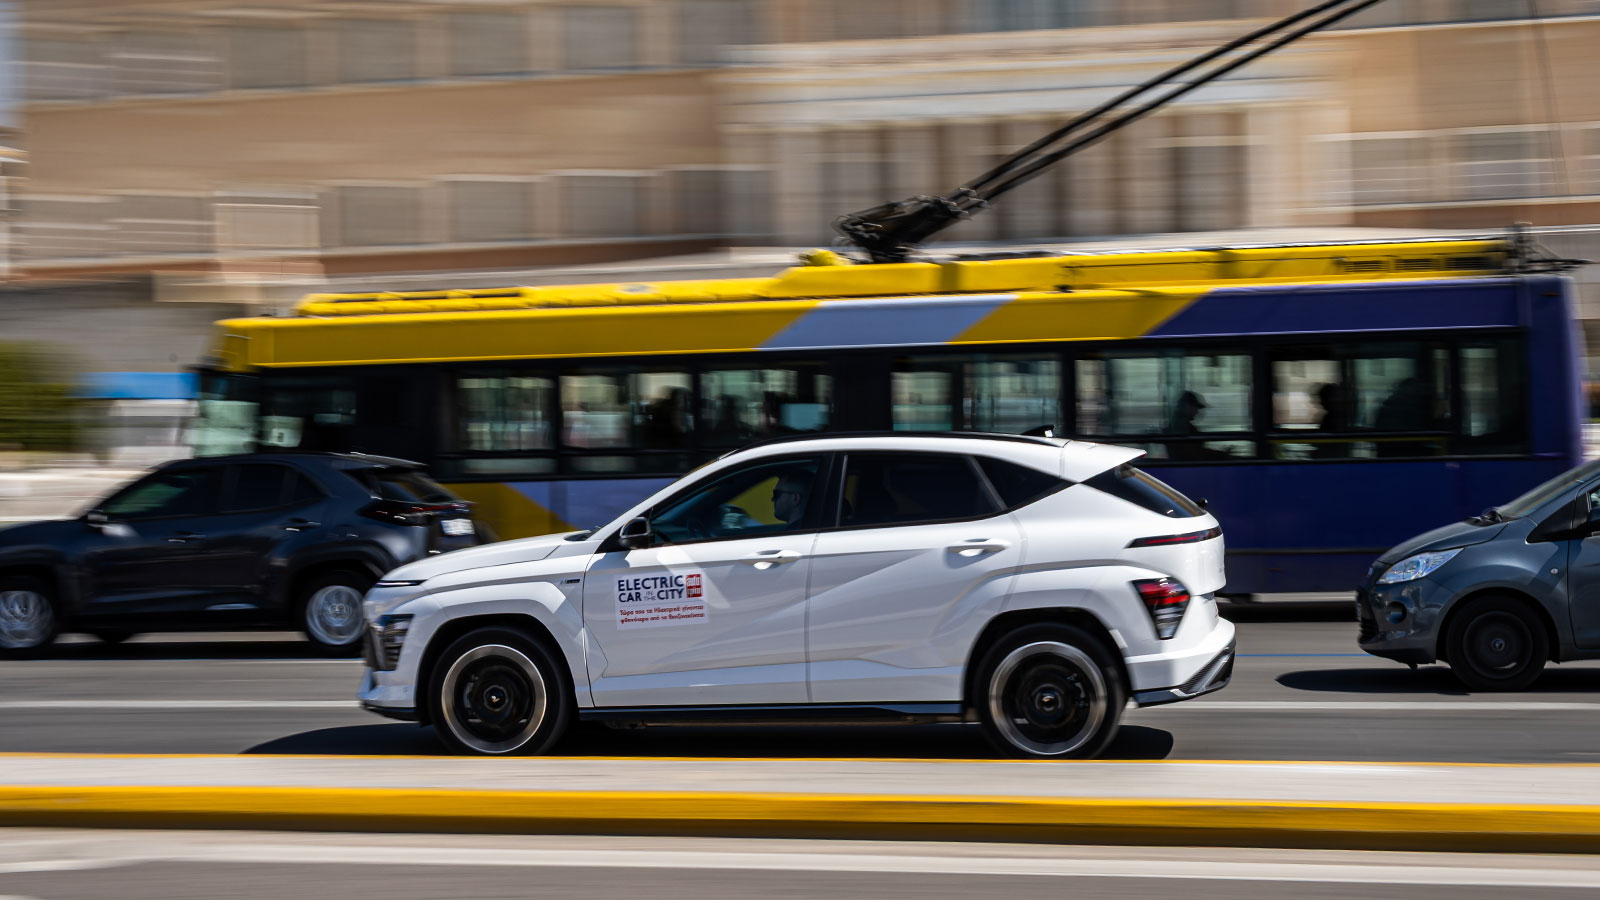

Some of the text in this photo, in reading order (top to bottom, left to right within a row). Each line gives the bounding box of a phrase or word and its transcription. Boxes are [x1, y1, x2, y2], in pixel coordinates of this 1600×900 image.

[618, 575, 684, 592] ELECTRIC
[618, 592, 642, 602] CAR
[657, 588, 684, 600] CITY
